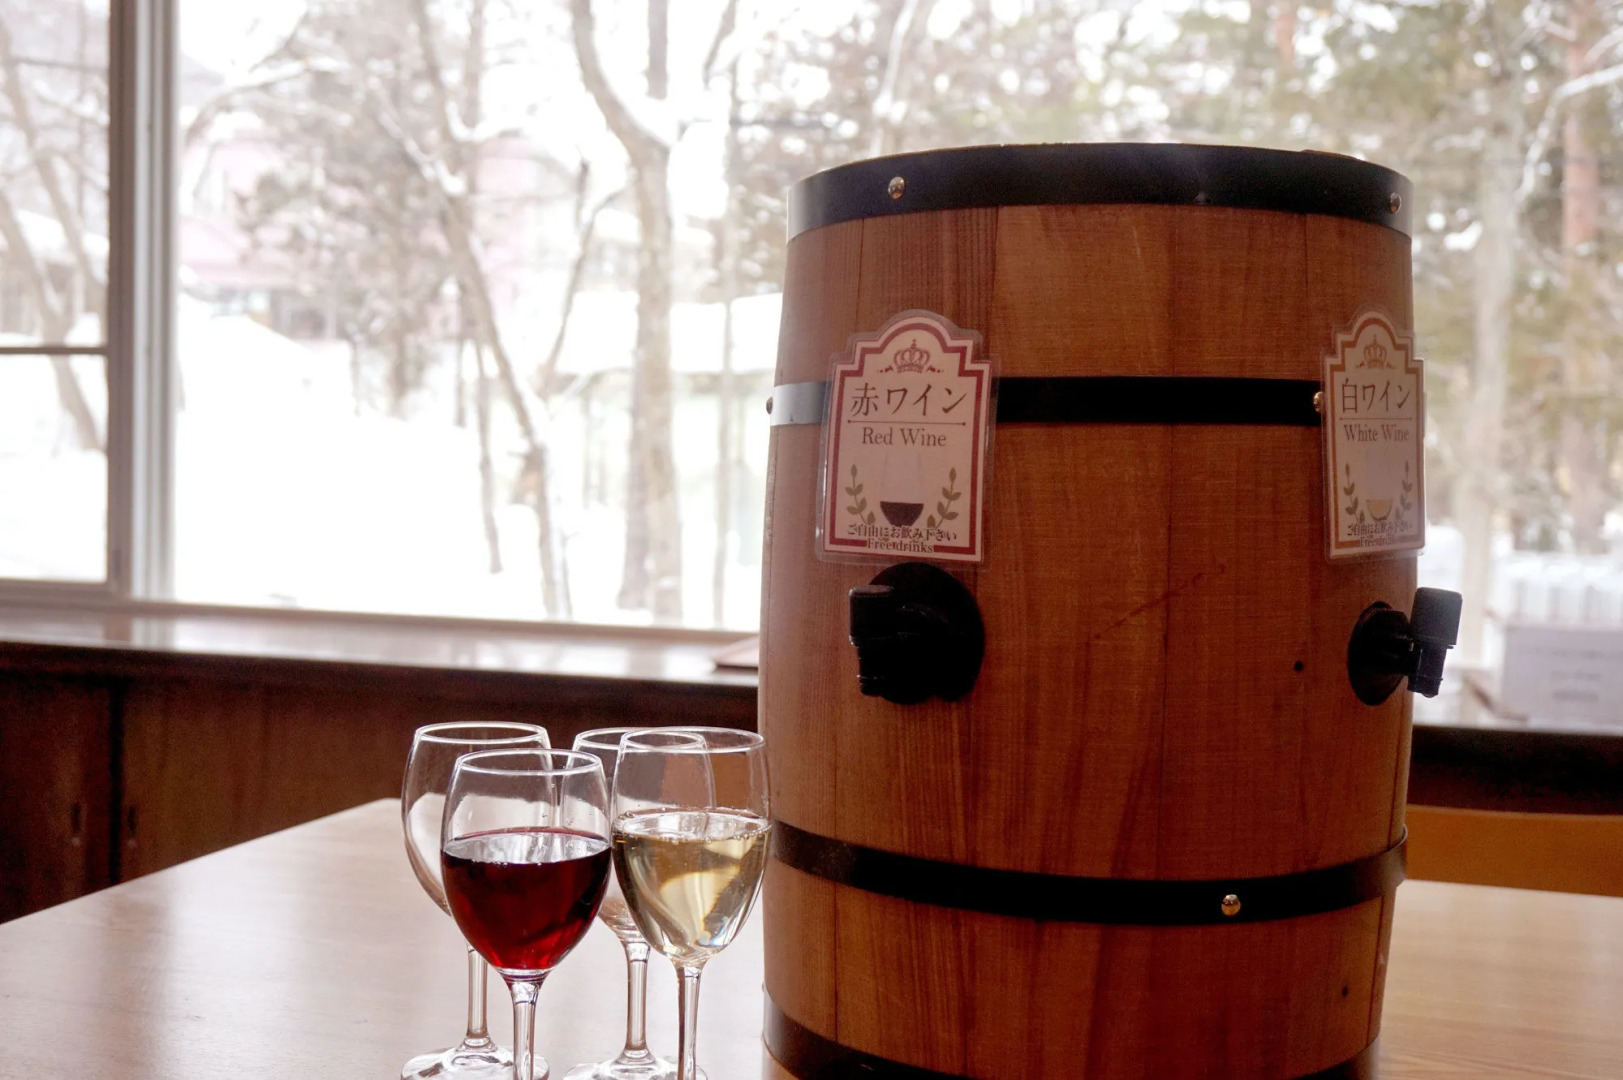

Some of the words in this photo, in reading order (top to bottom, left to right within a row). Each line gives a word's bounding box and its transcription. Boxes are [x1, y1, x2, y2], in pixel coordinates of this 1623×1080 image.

[850, 382, 967, 416] 赤ワイン
[1342, 377, 1410, 413] 白ワイン
[862, 427, 893, 446] Red
[899, 428, 947, 447] Wine
[1344, 424, 1378, 442] White
[1381, 424, 1409, 441] Wine
